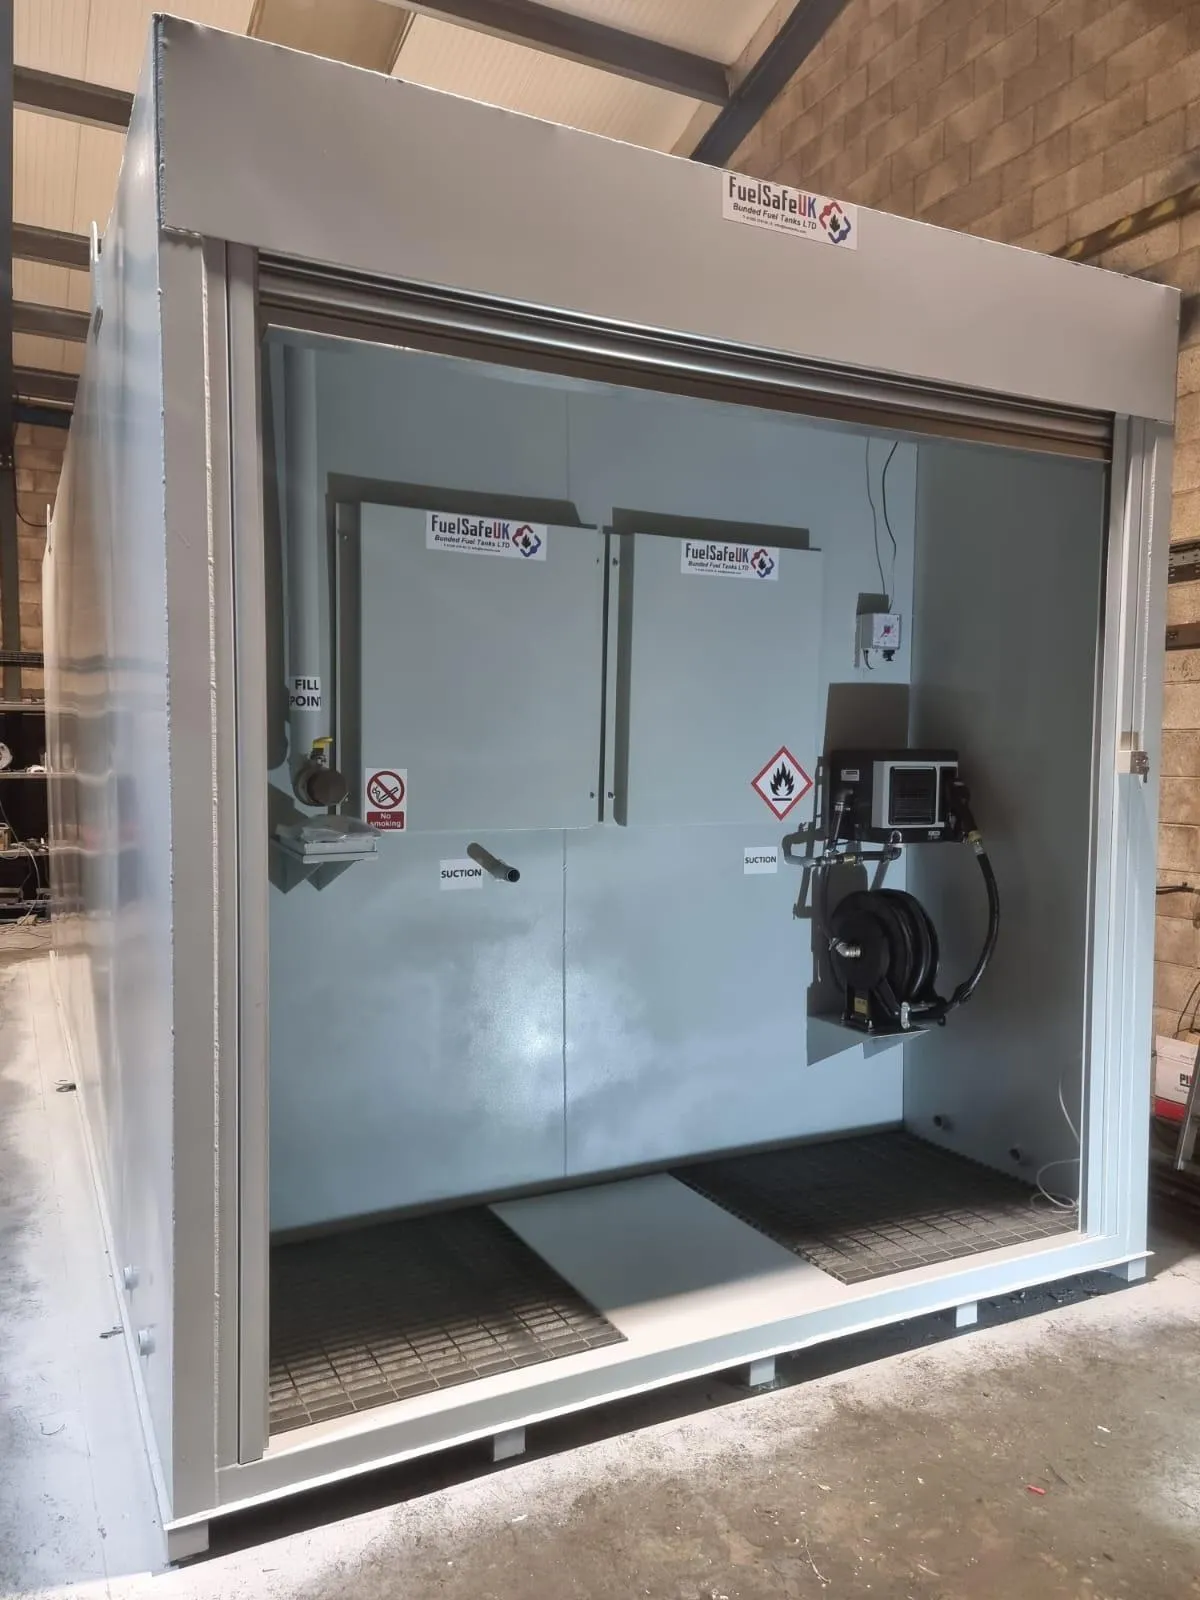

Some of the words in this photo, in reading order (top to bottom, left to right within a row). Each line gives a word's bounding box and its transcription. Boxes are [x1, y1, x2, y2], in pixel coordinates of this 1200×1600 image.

[729, 175, 817, 219] FuelSafeUK
[733, 202, 761, 216] Bunded
[762, 210, 778, 220] Fuel
[781, 214, 801, 226] Tanks
[803, 220, 817, 230] LTD
[431, 514, 510, 540] FuelSafeUK
[435, 534, 460, 543] Bunded
[461, 537, 475, 545] Fuel
[477, 539, 496, 548] Tanks
[497, 541, 510, 549] LTD
[685, 543, 749, 563] FuelSafeUK
[295, 679, 319, 690] FILL
[744, 856, 777, 864] SUCTION
[441, 869, 482, 878] SUCTION
